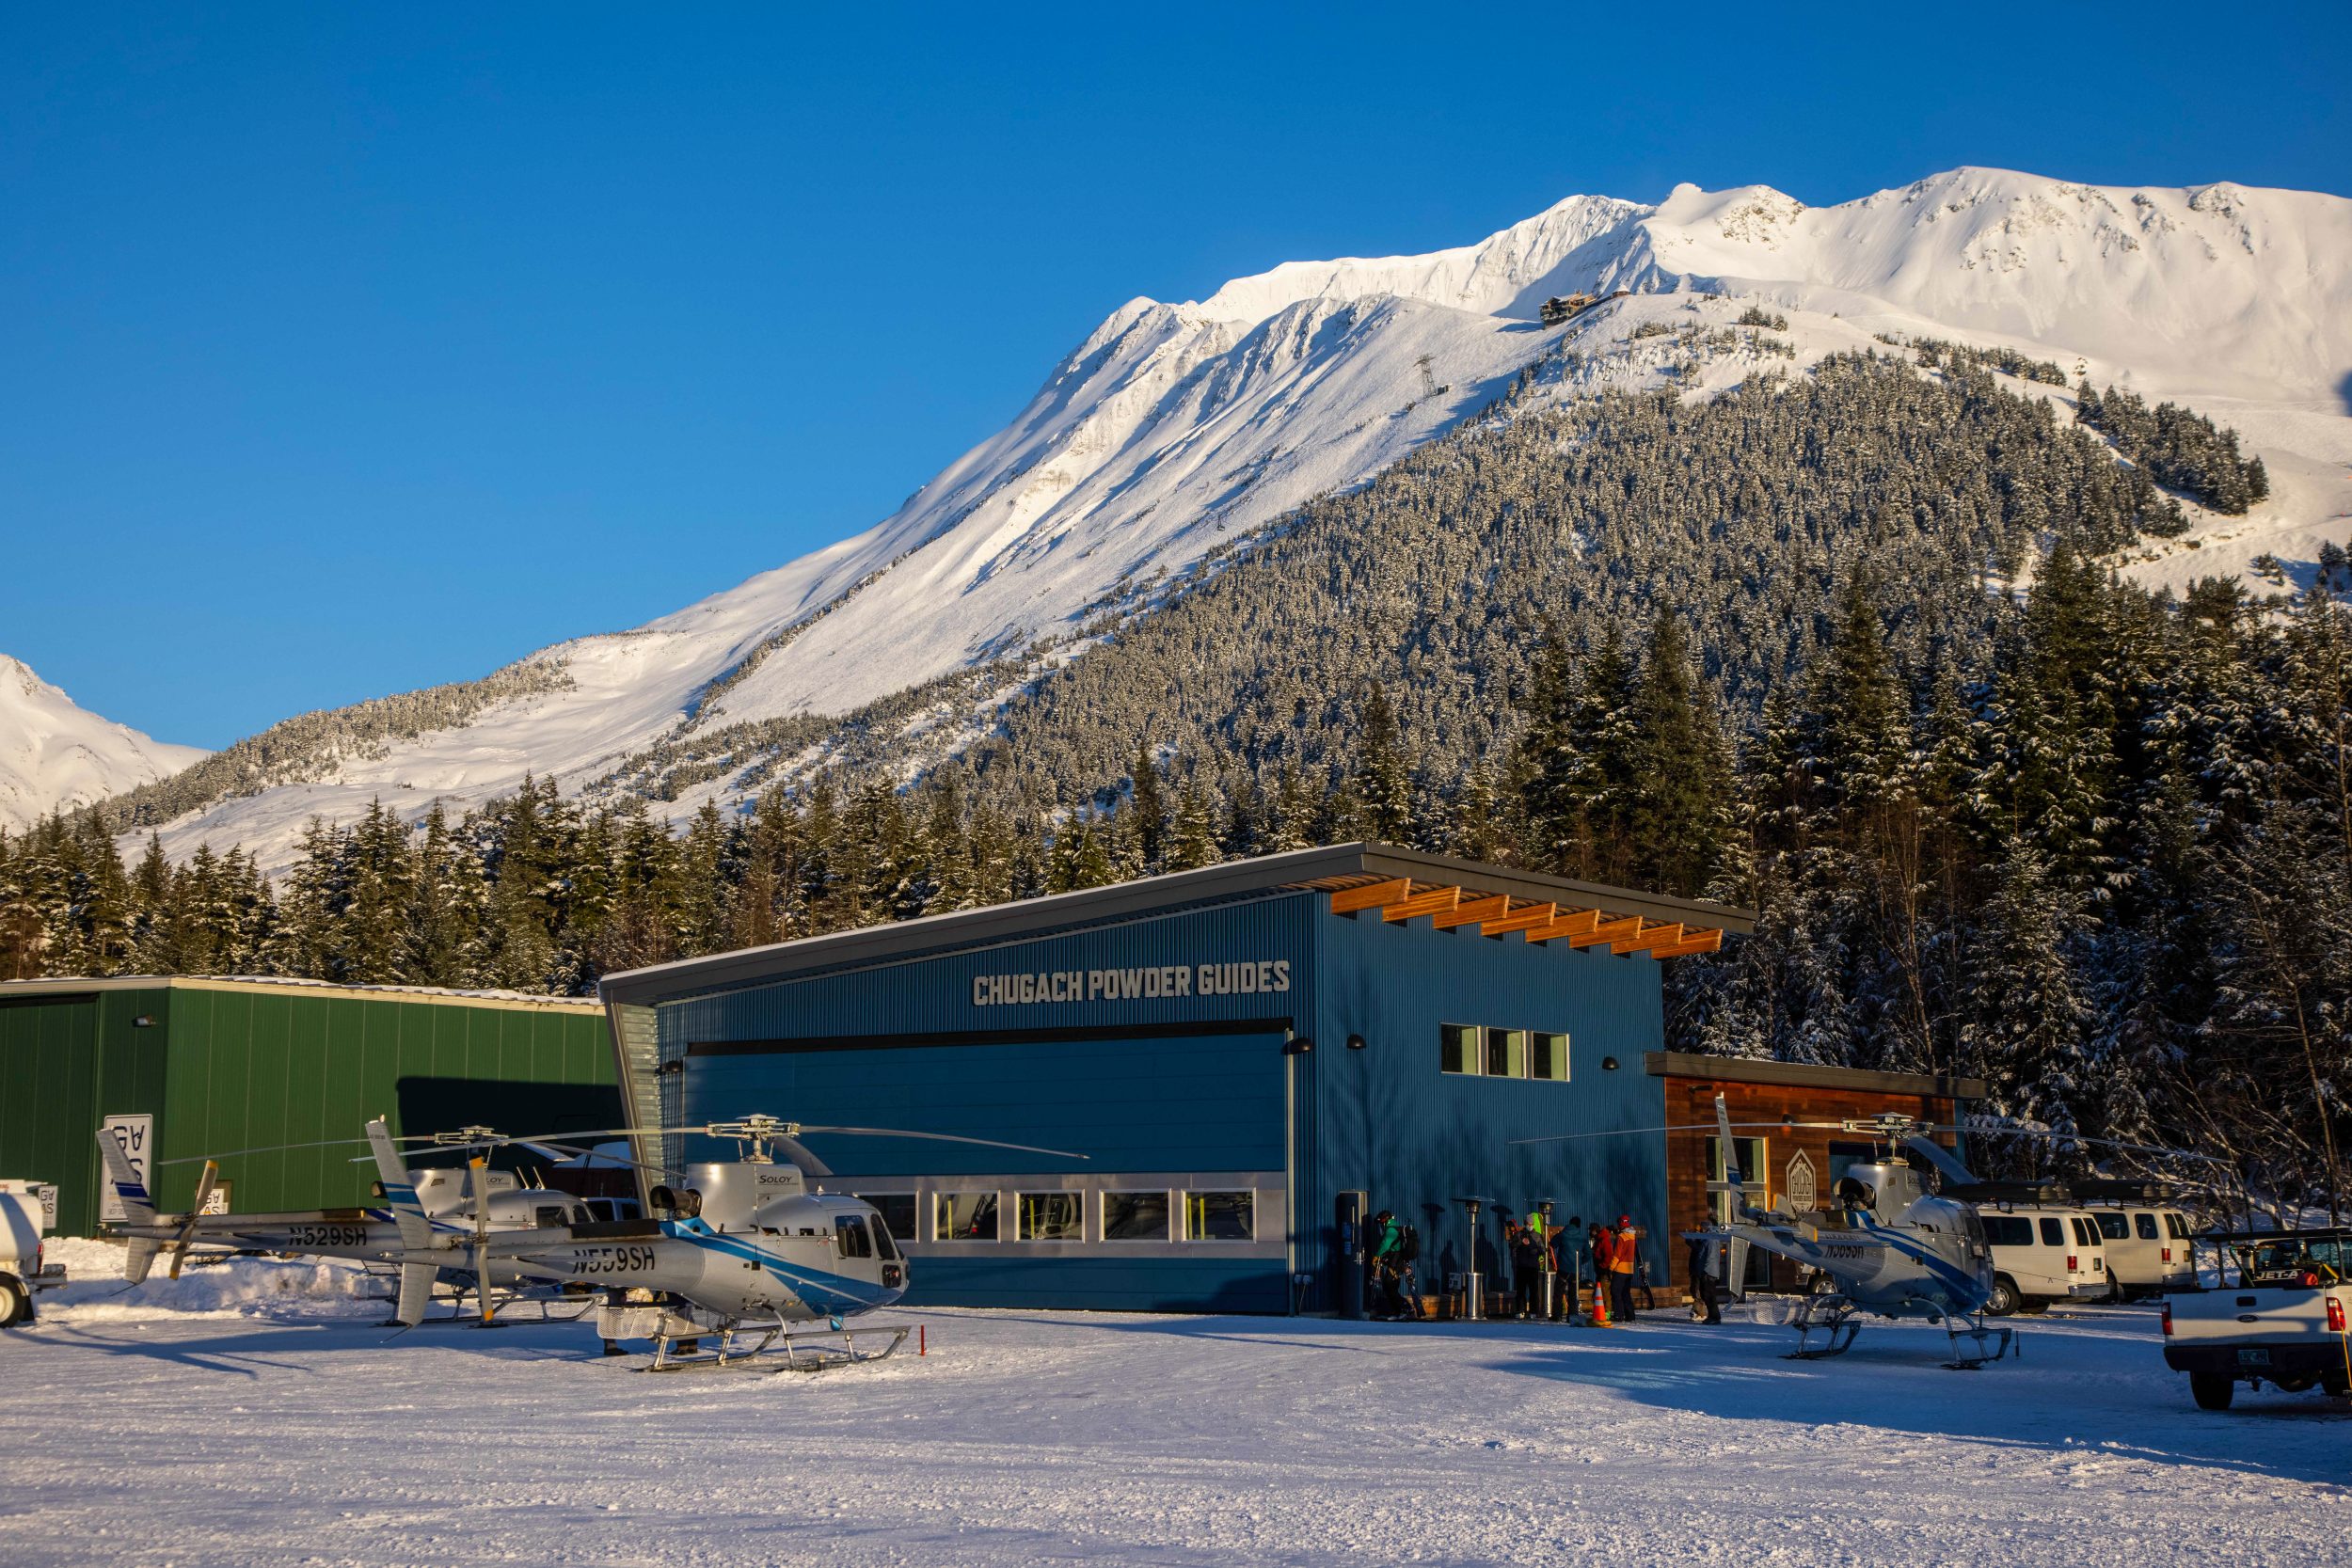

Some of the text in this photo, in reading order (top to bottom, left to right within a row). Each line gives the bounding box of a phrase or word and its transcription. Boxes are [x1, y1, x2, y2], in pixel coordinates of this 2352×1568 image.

[973, 960, 1291, 1006] CHUGACH POWDER GUIDES
[759, 1175, 792, 1184] SOLOY
[289, 1227, 367, 1246] N529SH
[572, 1246, 656, 1274] N559SH
[2256, 1270, 2299, 1280] JET-A
